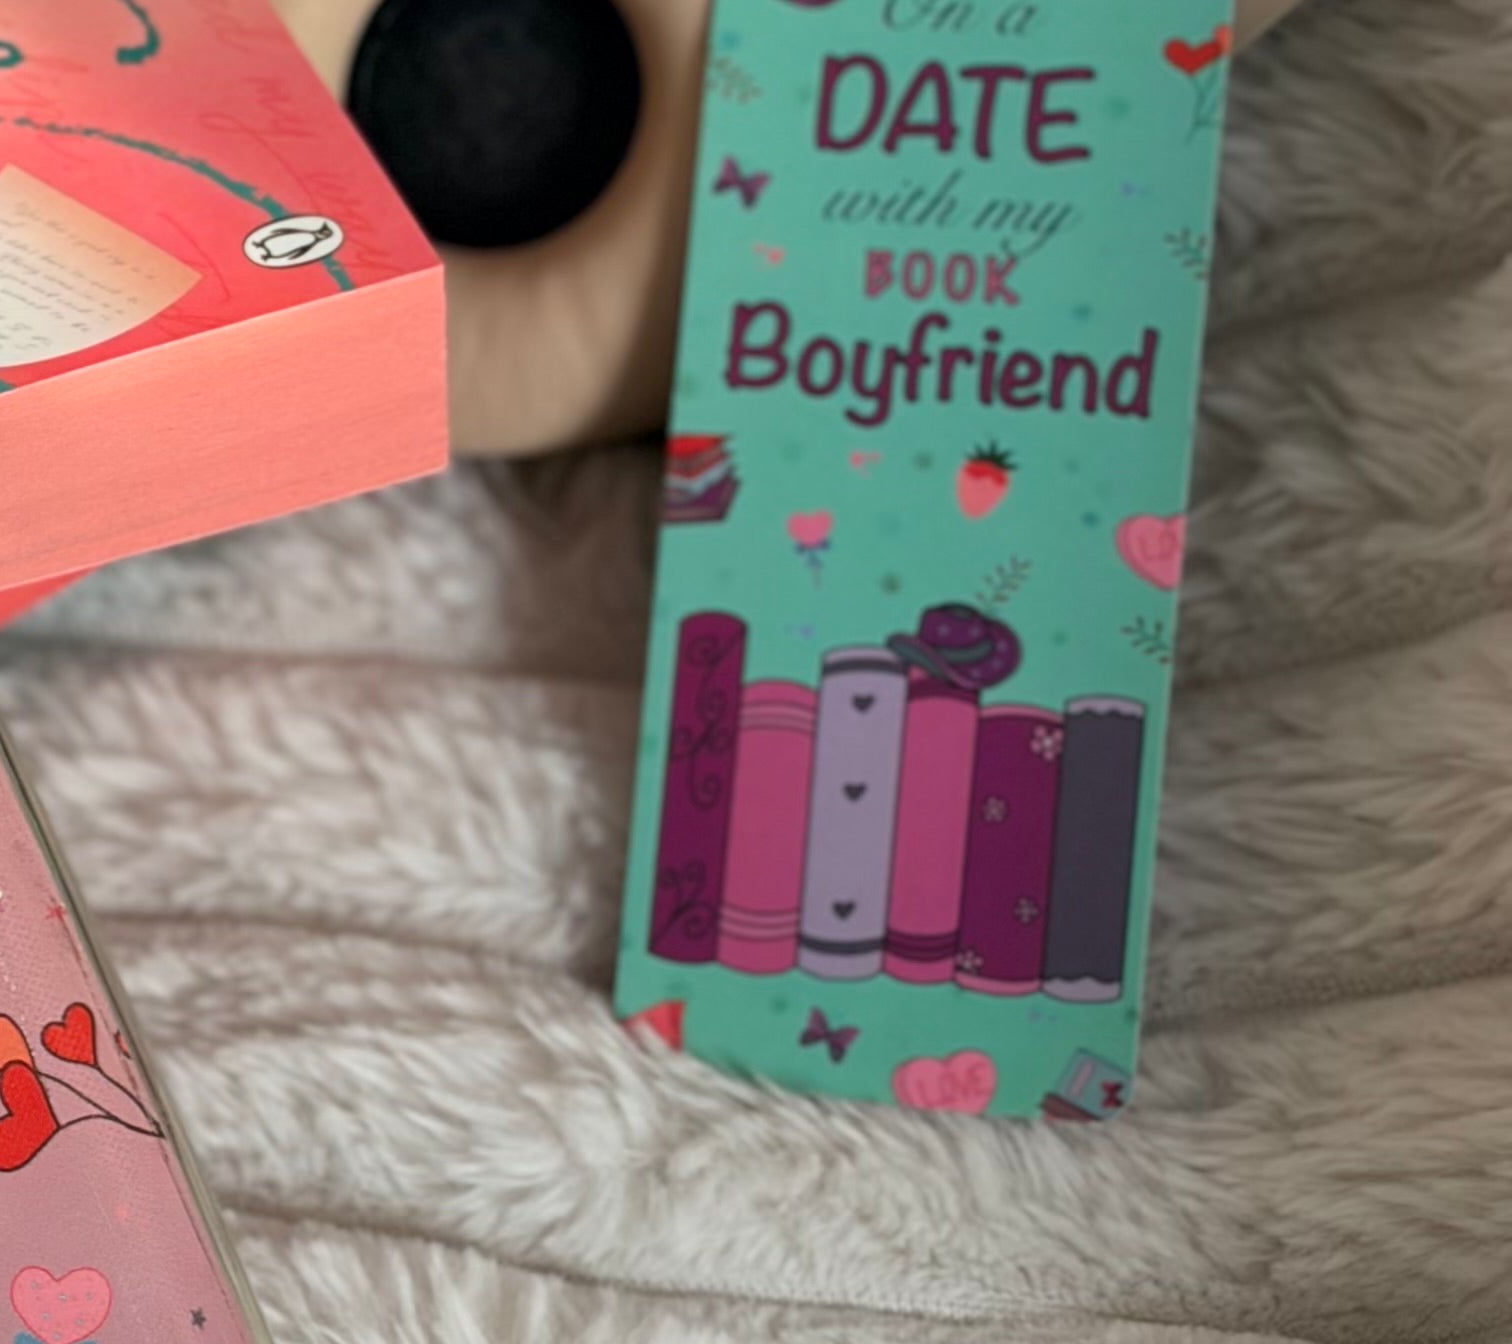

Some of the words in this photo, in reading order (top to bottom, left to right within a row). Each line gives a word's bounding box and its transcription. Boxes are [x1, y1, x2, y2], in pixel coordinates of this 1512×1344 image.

[995, 0, 1039, 37] a
[813, 53, 1097, 165] DATE
[821, 168, 967, 229] with
[973, 191, 1080, 262] my
[863, 248, 1021, 307] BOOK
[723, 301, 1161, 429] Boyfriend
